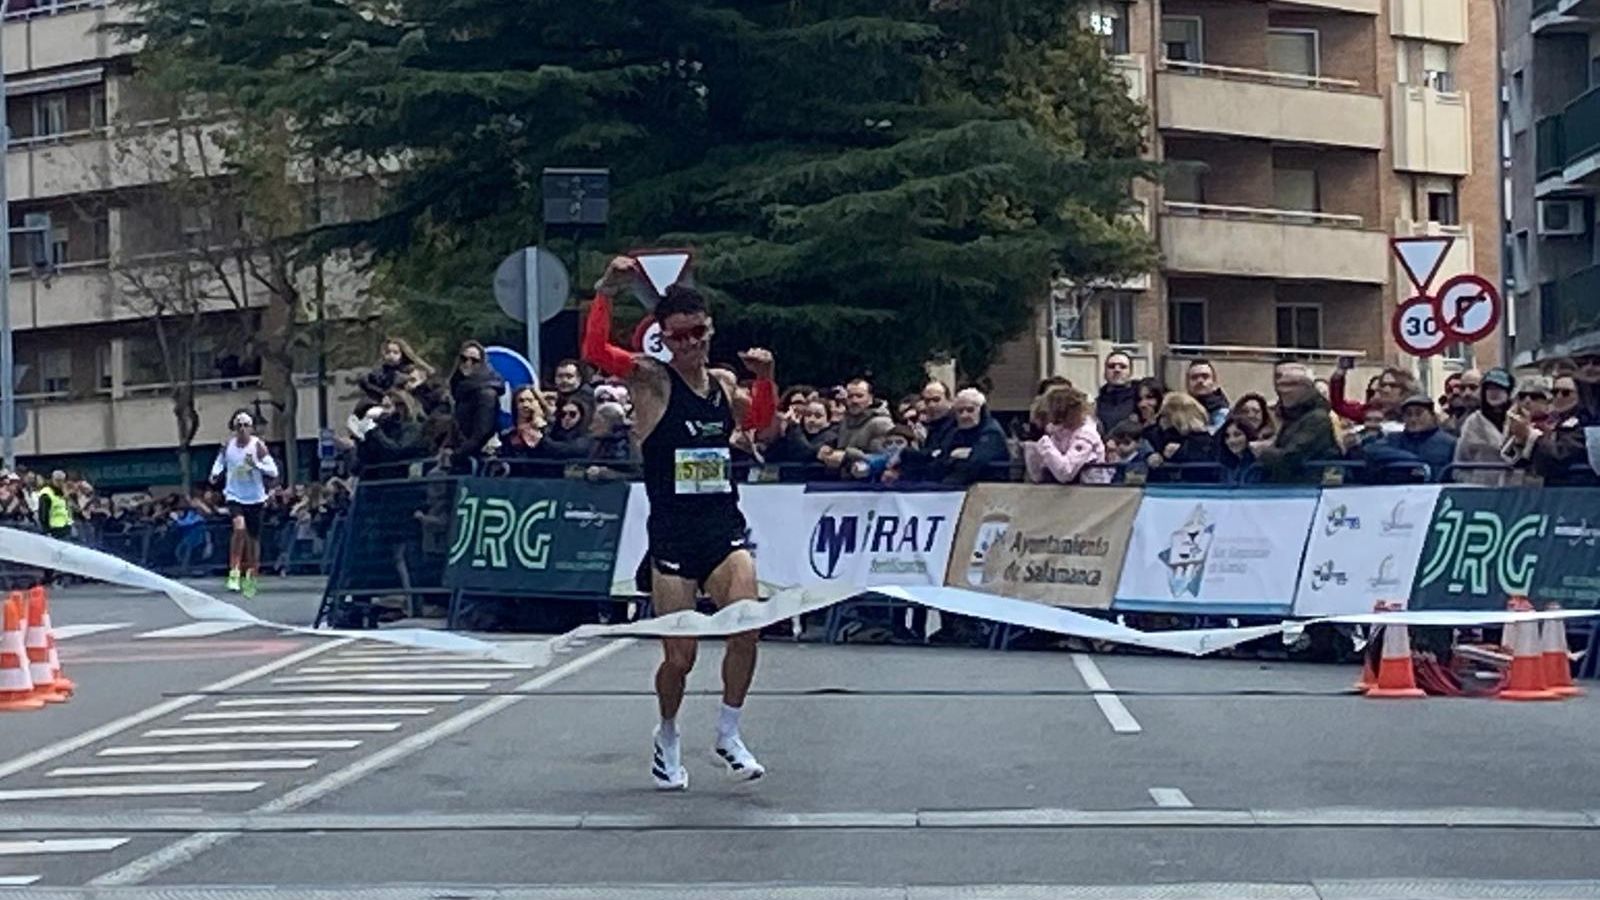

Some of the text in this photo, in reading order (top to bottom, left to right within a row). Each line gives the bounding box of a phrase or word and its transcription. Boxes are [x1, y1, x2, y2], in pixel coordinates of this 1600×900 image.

[1406, 317, 1438, 336] 30
[650, 333, 664, 353] 3
[449, 488, 557, 570] JRG
[1420, 497, 1548, 595] JRG
[1023, 560, 1102, 586] Salamanca
